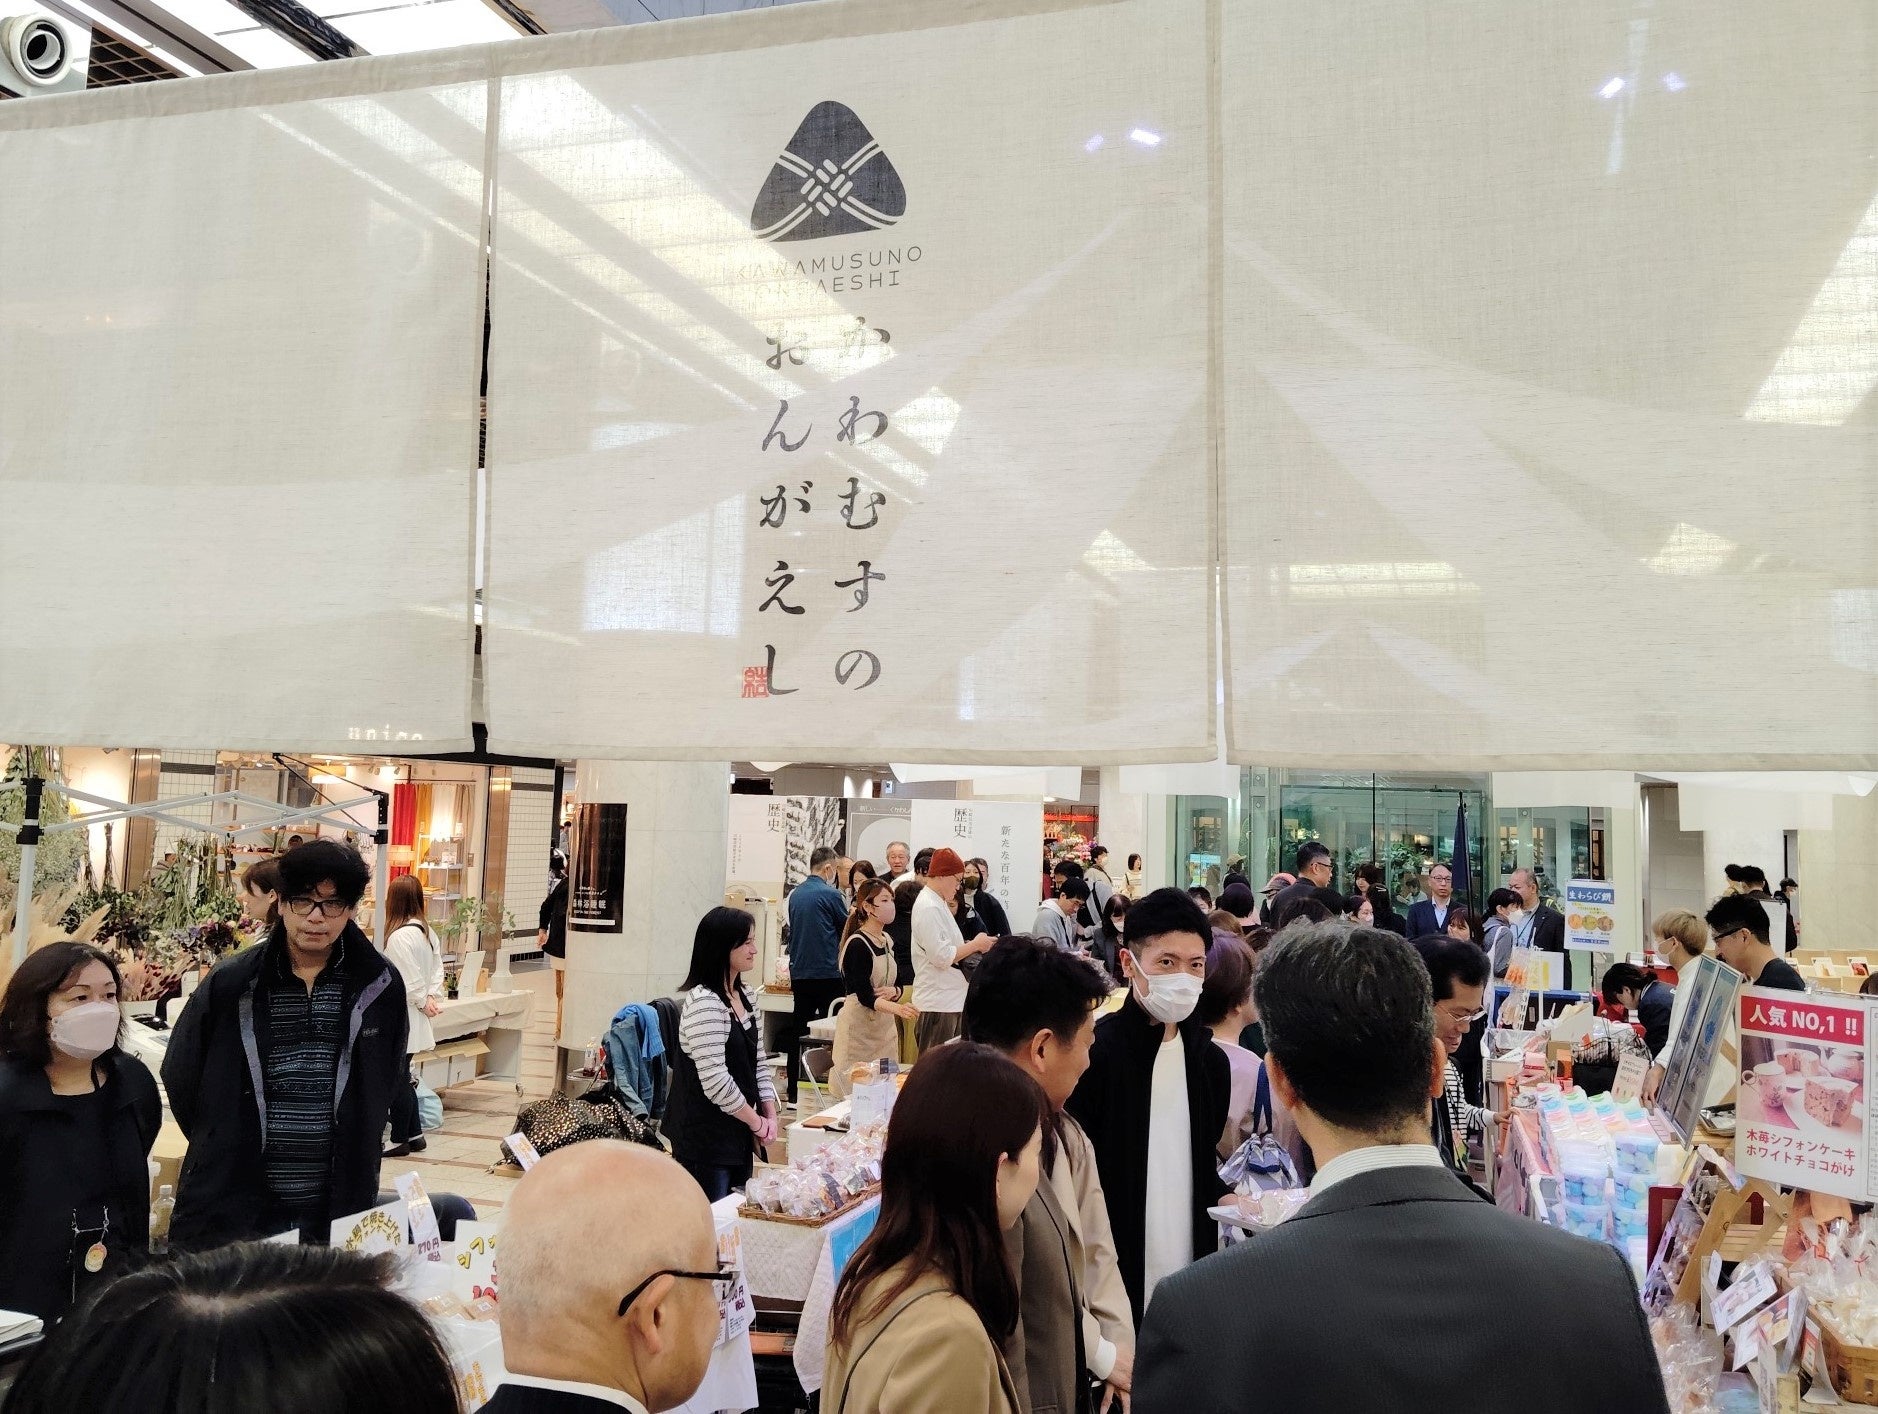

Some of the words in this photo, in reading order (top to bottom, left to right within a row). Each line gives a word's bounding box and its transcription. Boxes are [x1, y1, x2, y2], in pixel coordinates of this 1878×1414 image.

[758, 326, 813, 697] おんがえし
[834, 315, 891, 691] かわむすの
[953, 807, 967, 838] 歴史
[1749, 1004, 1787, 1028] 人気
[1791, 1010, 1835, 1034] NO,1
[1746, 1128, 1856, 1161] 木苺シフォンケーキ
[1746, 1144, 1855, 1177] ホワイトチョコがけ
